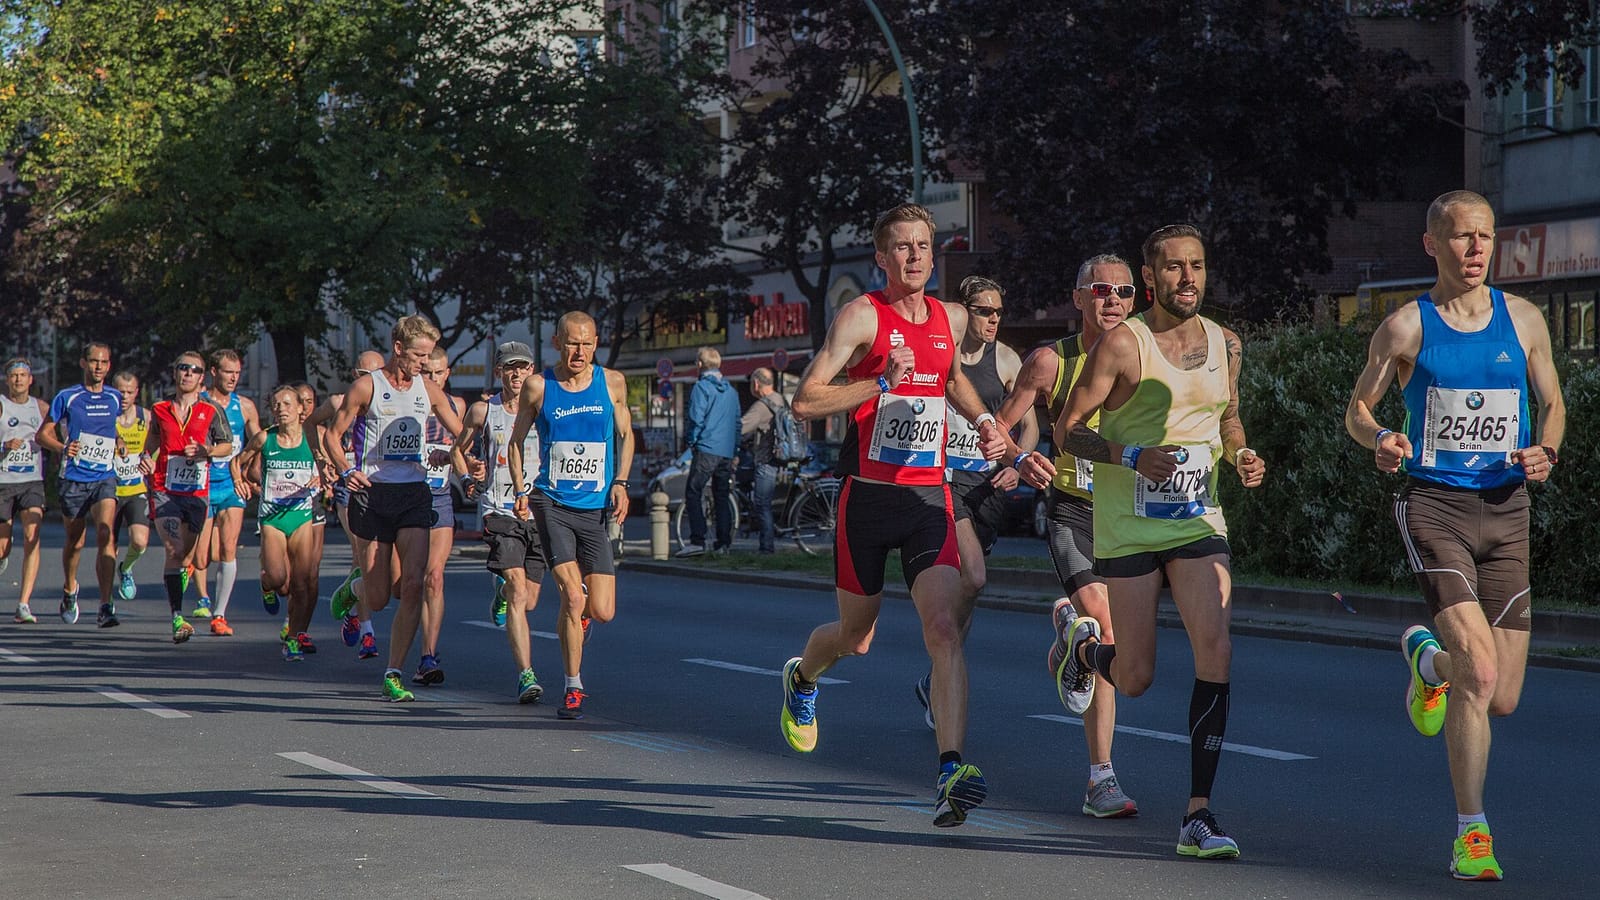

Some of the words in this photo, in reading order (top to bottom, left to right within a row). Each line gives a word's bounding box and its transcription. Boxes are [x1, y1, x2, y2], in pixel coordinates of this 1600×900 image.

[1547, 256, 1578, 274] private
[912, 371, 939, 383] bunert
[885, 419, 938, 442] 30306
[1438, 416, 1507, 441] 25465
[1511, 414, 1518, 423] A
[386, 434, 420, 449] 15826
[897, 442, 924, 450] Michael
[1459, 442, 1482, 450] Brian
[81, 445, 110, 460] 31942
[266, 460, 312, 469] FORESTALE
[559, 458, 598, 474] 16645
[1463, 454, 1481, 468] here
[1204, 465, 1209, 473] A
